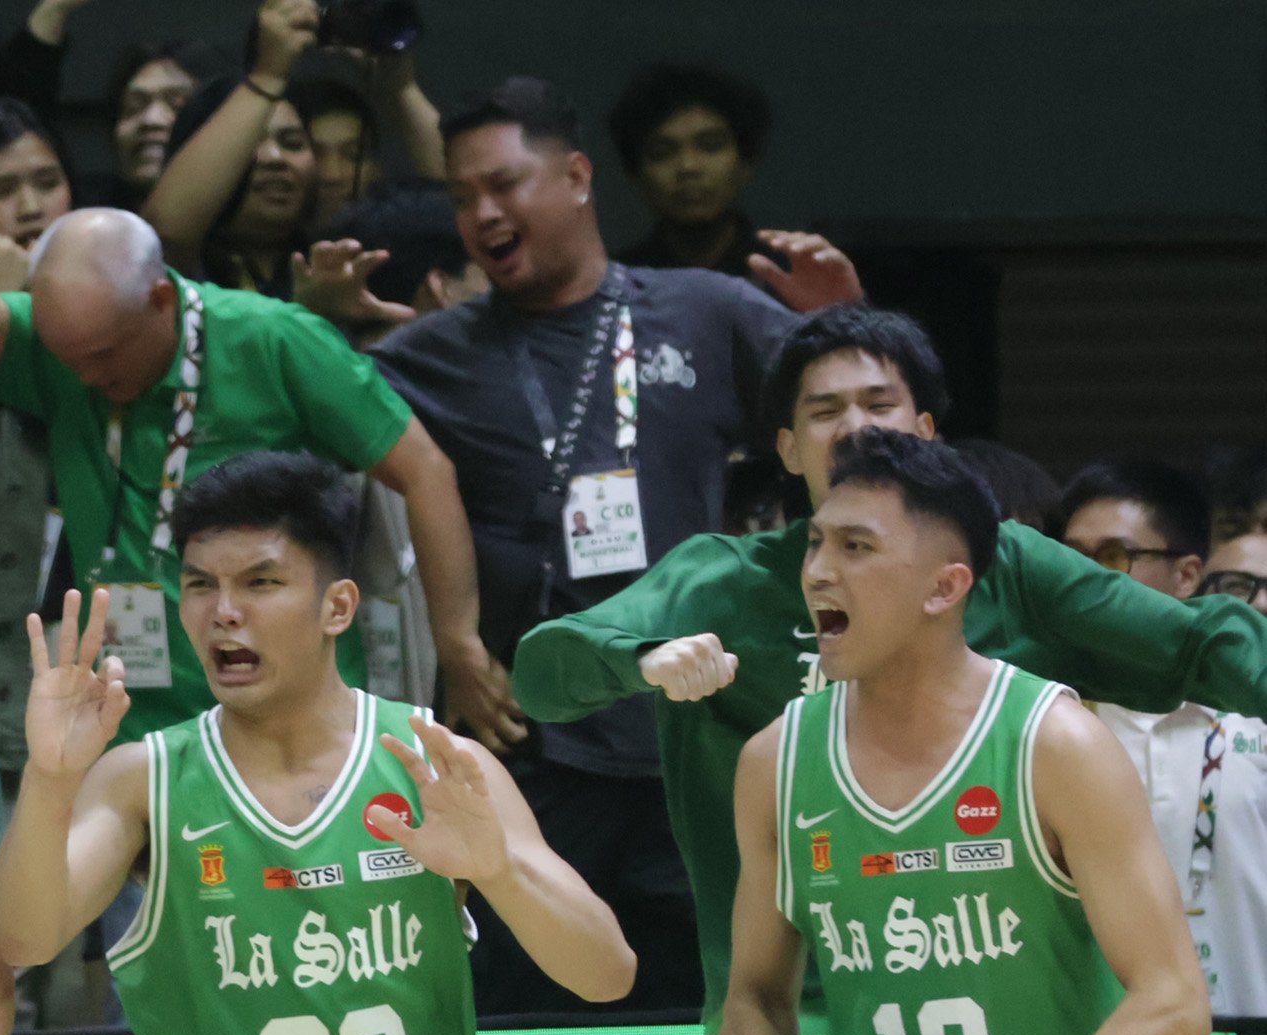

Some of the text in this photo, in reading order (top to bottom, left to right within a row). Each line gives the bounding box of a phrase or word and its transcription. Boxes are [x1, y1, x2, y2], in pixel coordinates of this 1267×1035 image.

[957, 804, 998, 818] Gazz
[896, 850, 938, 870] ICTSI
[205, 900, 422, 990] La Salle
[809, 892, 1023, 974] La Salle
